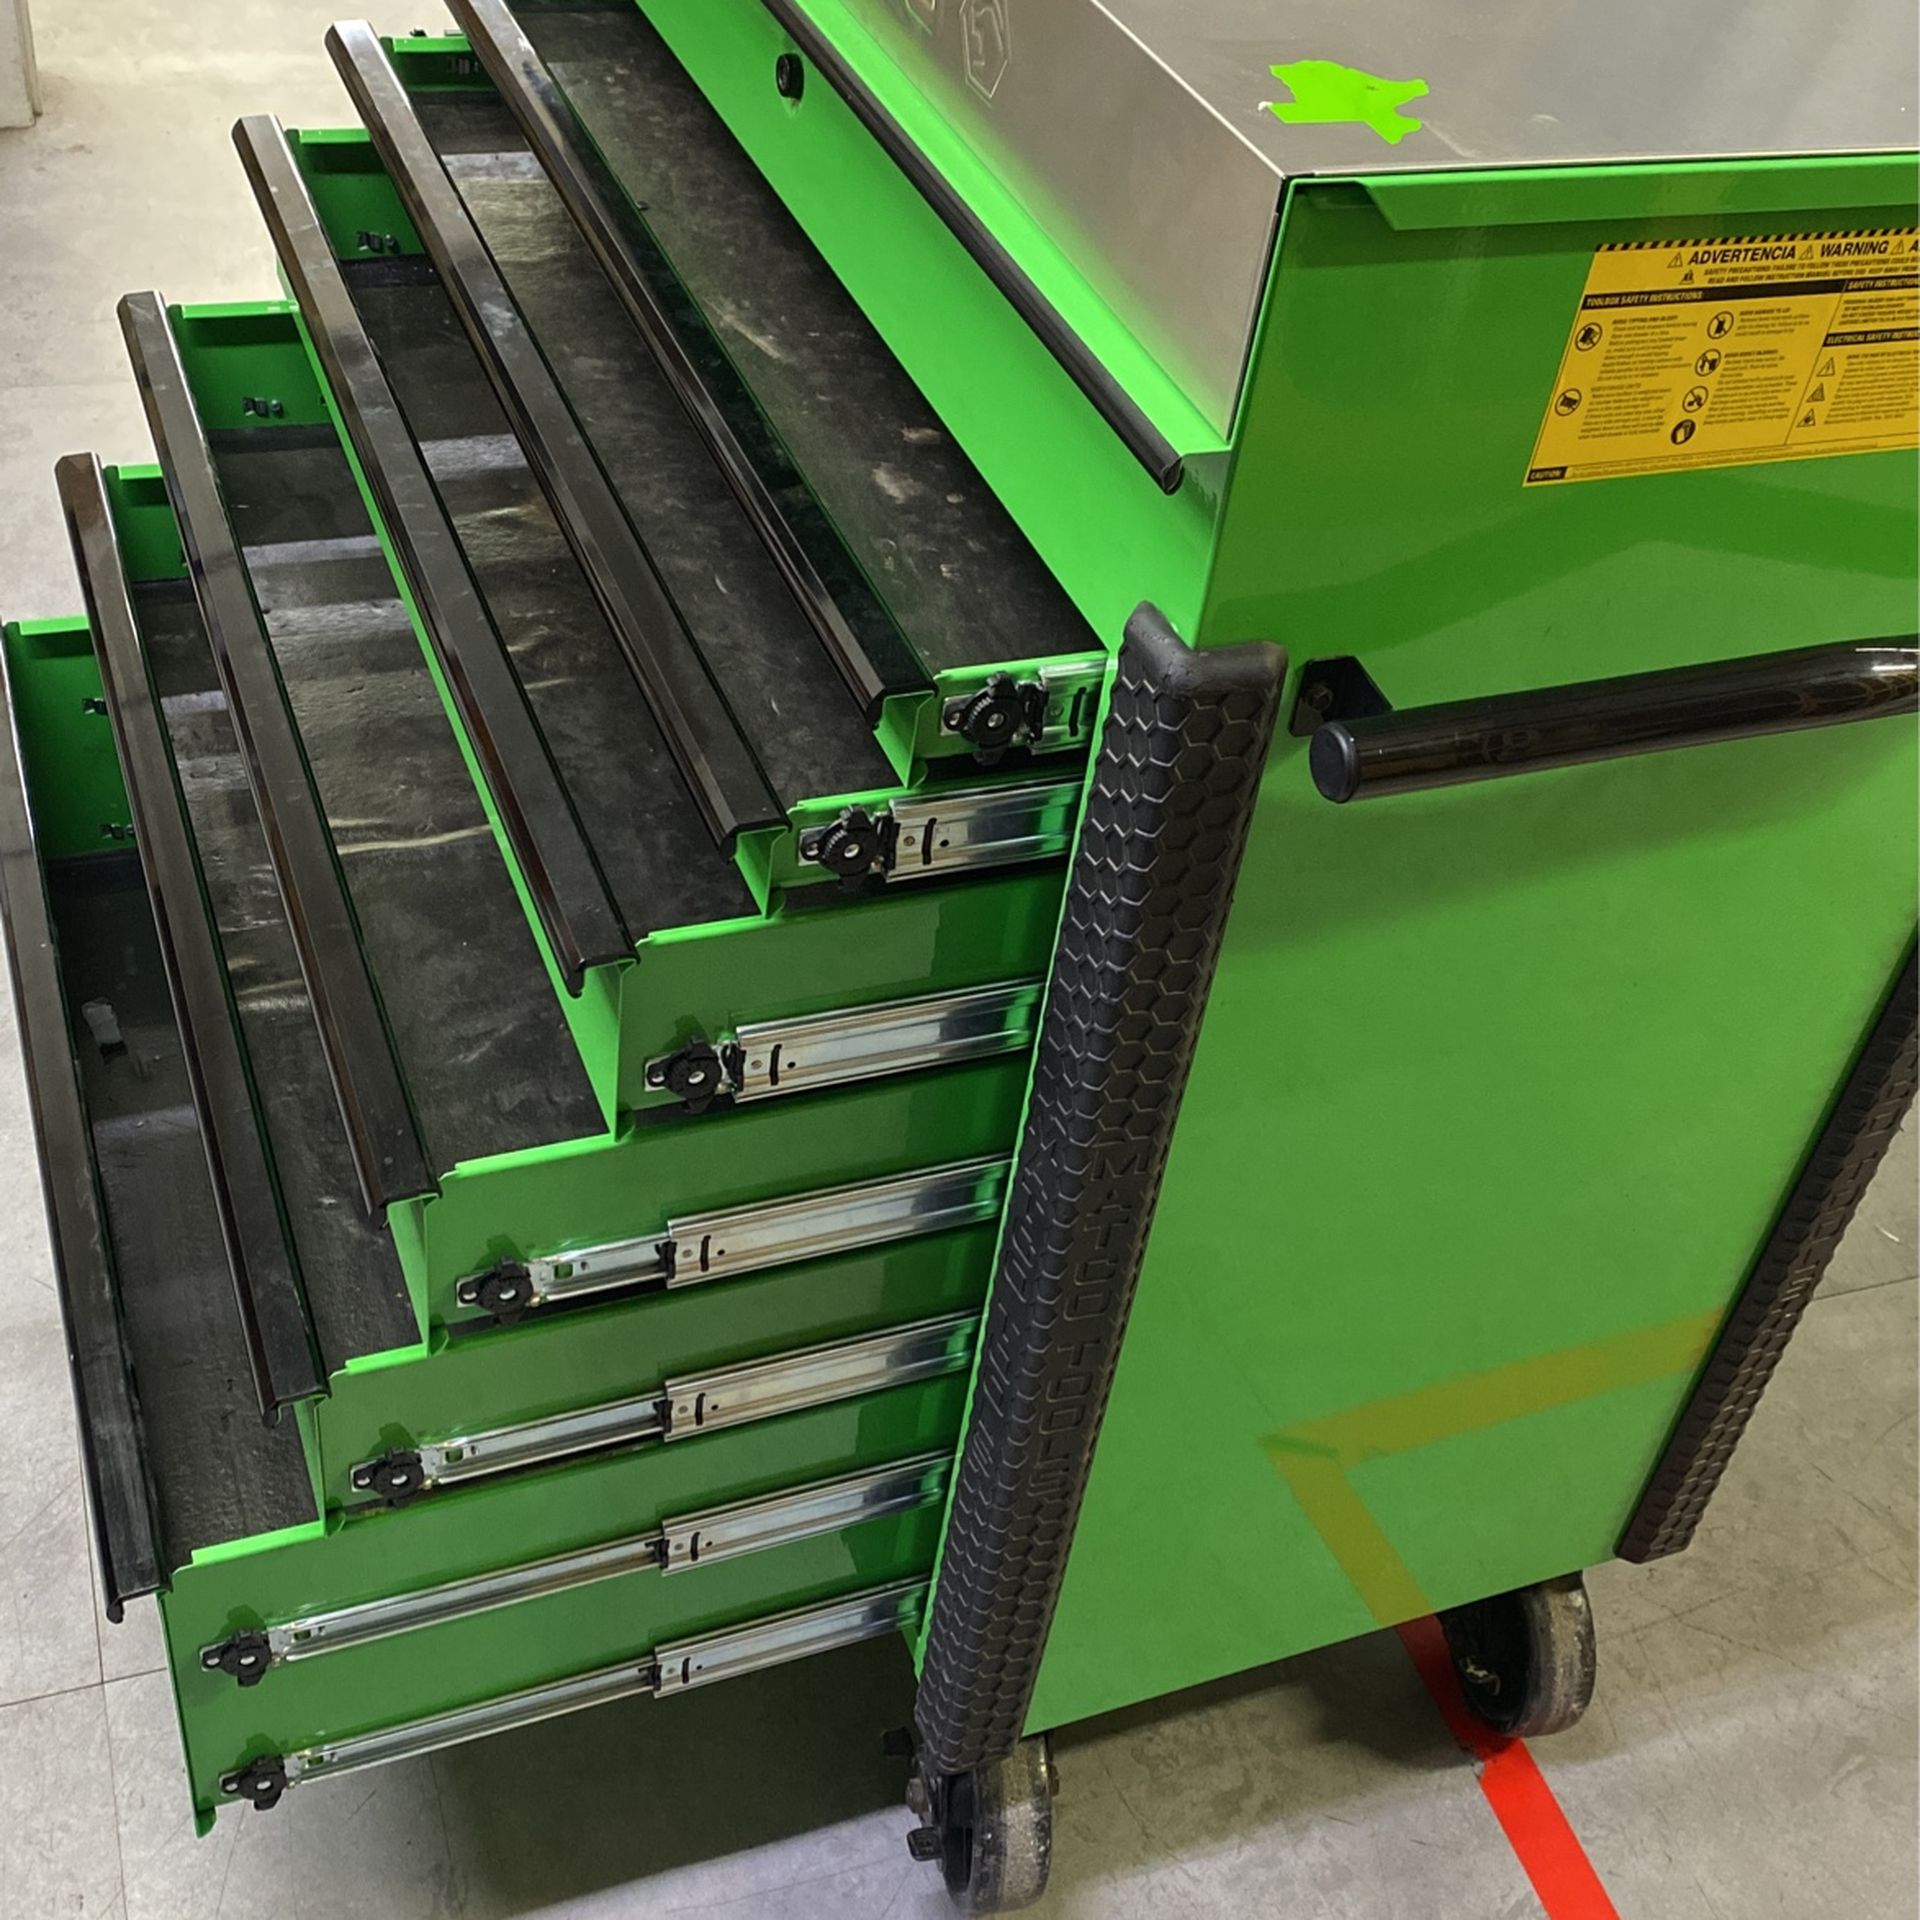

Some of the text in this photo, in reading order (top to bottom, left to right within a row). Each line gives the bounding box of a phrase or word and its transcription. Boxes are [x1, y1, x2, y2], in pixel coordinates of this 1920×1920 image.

[1688, 245, 1796, 265] ADVERTENCIA
[1820, 240, 1890, 258] WARNING
[1848, 280, 1874, 290] SAFETY
[1586, 296, 1620, 307] TOOLBOX
[1621, 294, 1649, 305] SAFETY
[1826, 334, 1865, 345] ELECTRICAL
[1866, 332, 1892, 342] SAFETY
